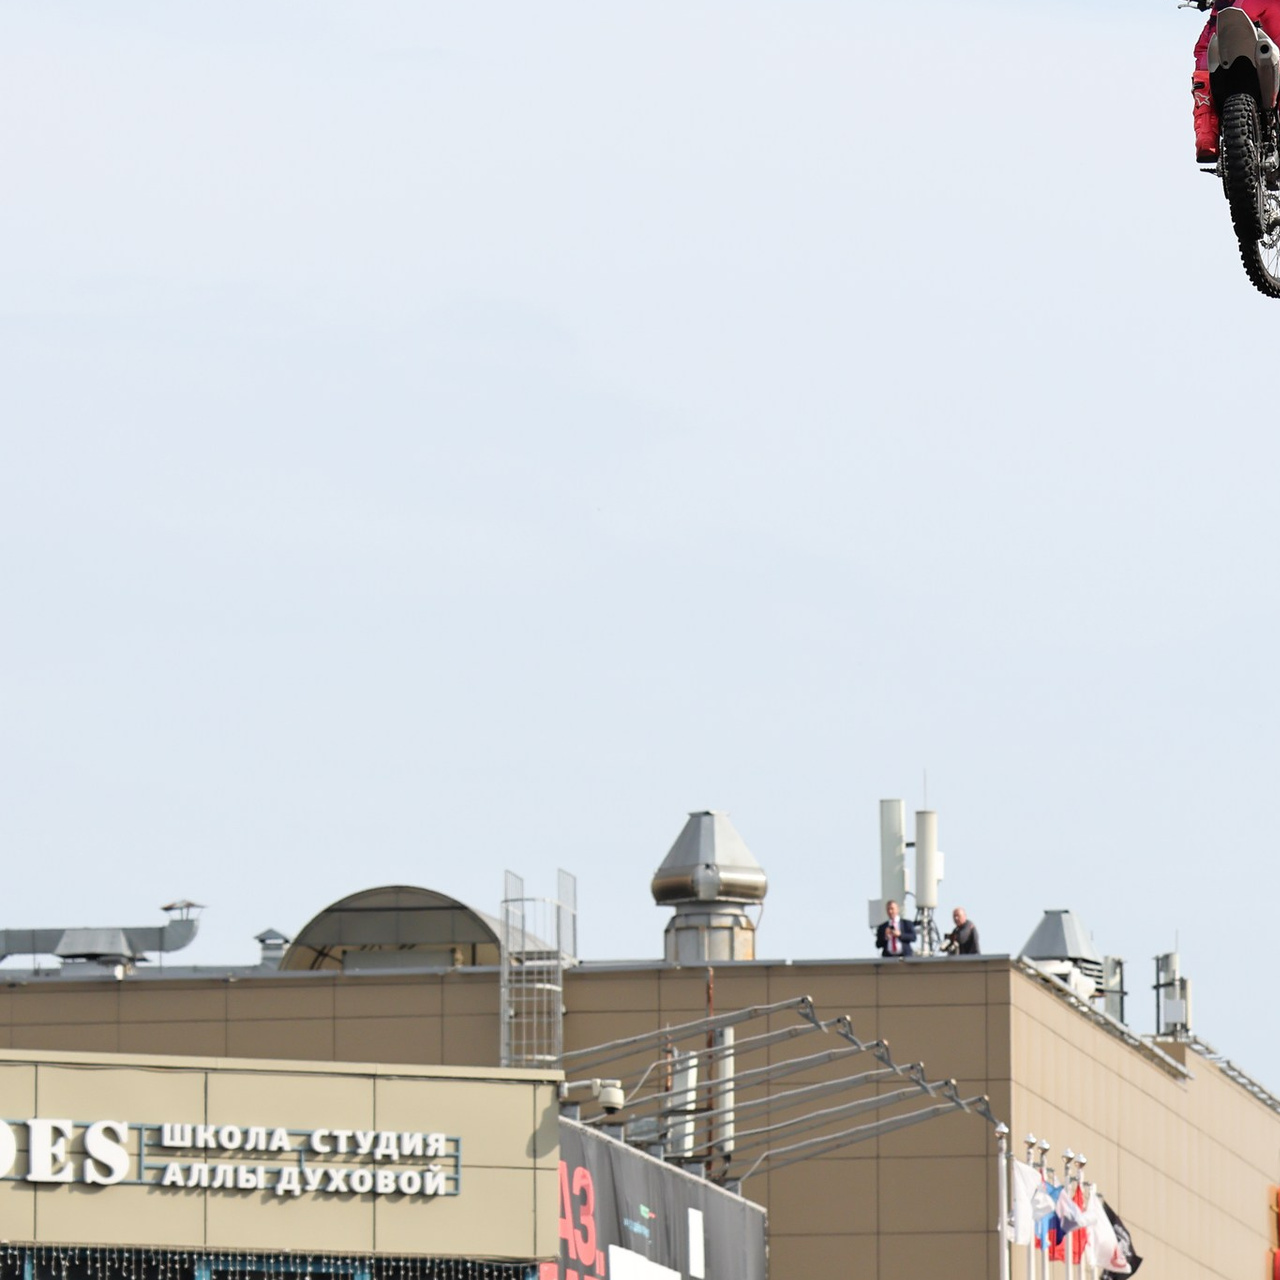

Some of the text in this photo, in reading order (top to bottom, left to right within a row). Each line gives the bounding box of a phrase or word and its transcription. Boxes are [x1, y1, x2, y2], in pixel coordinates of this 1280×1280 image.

[162, 1123, 446, 1160] ШКОЛА СТУДИЯ
[162, 1162, 446, 1197] АЛЛЫ ДУХОВОЙ
